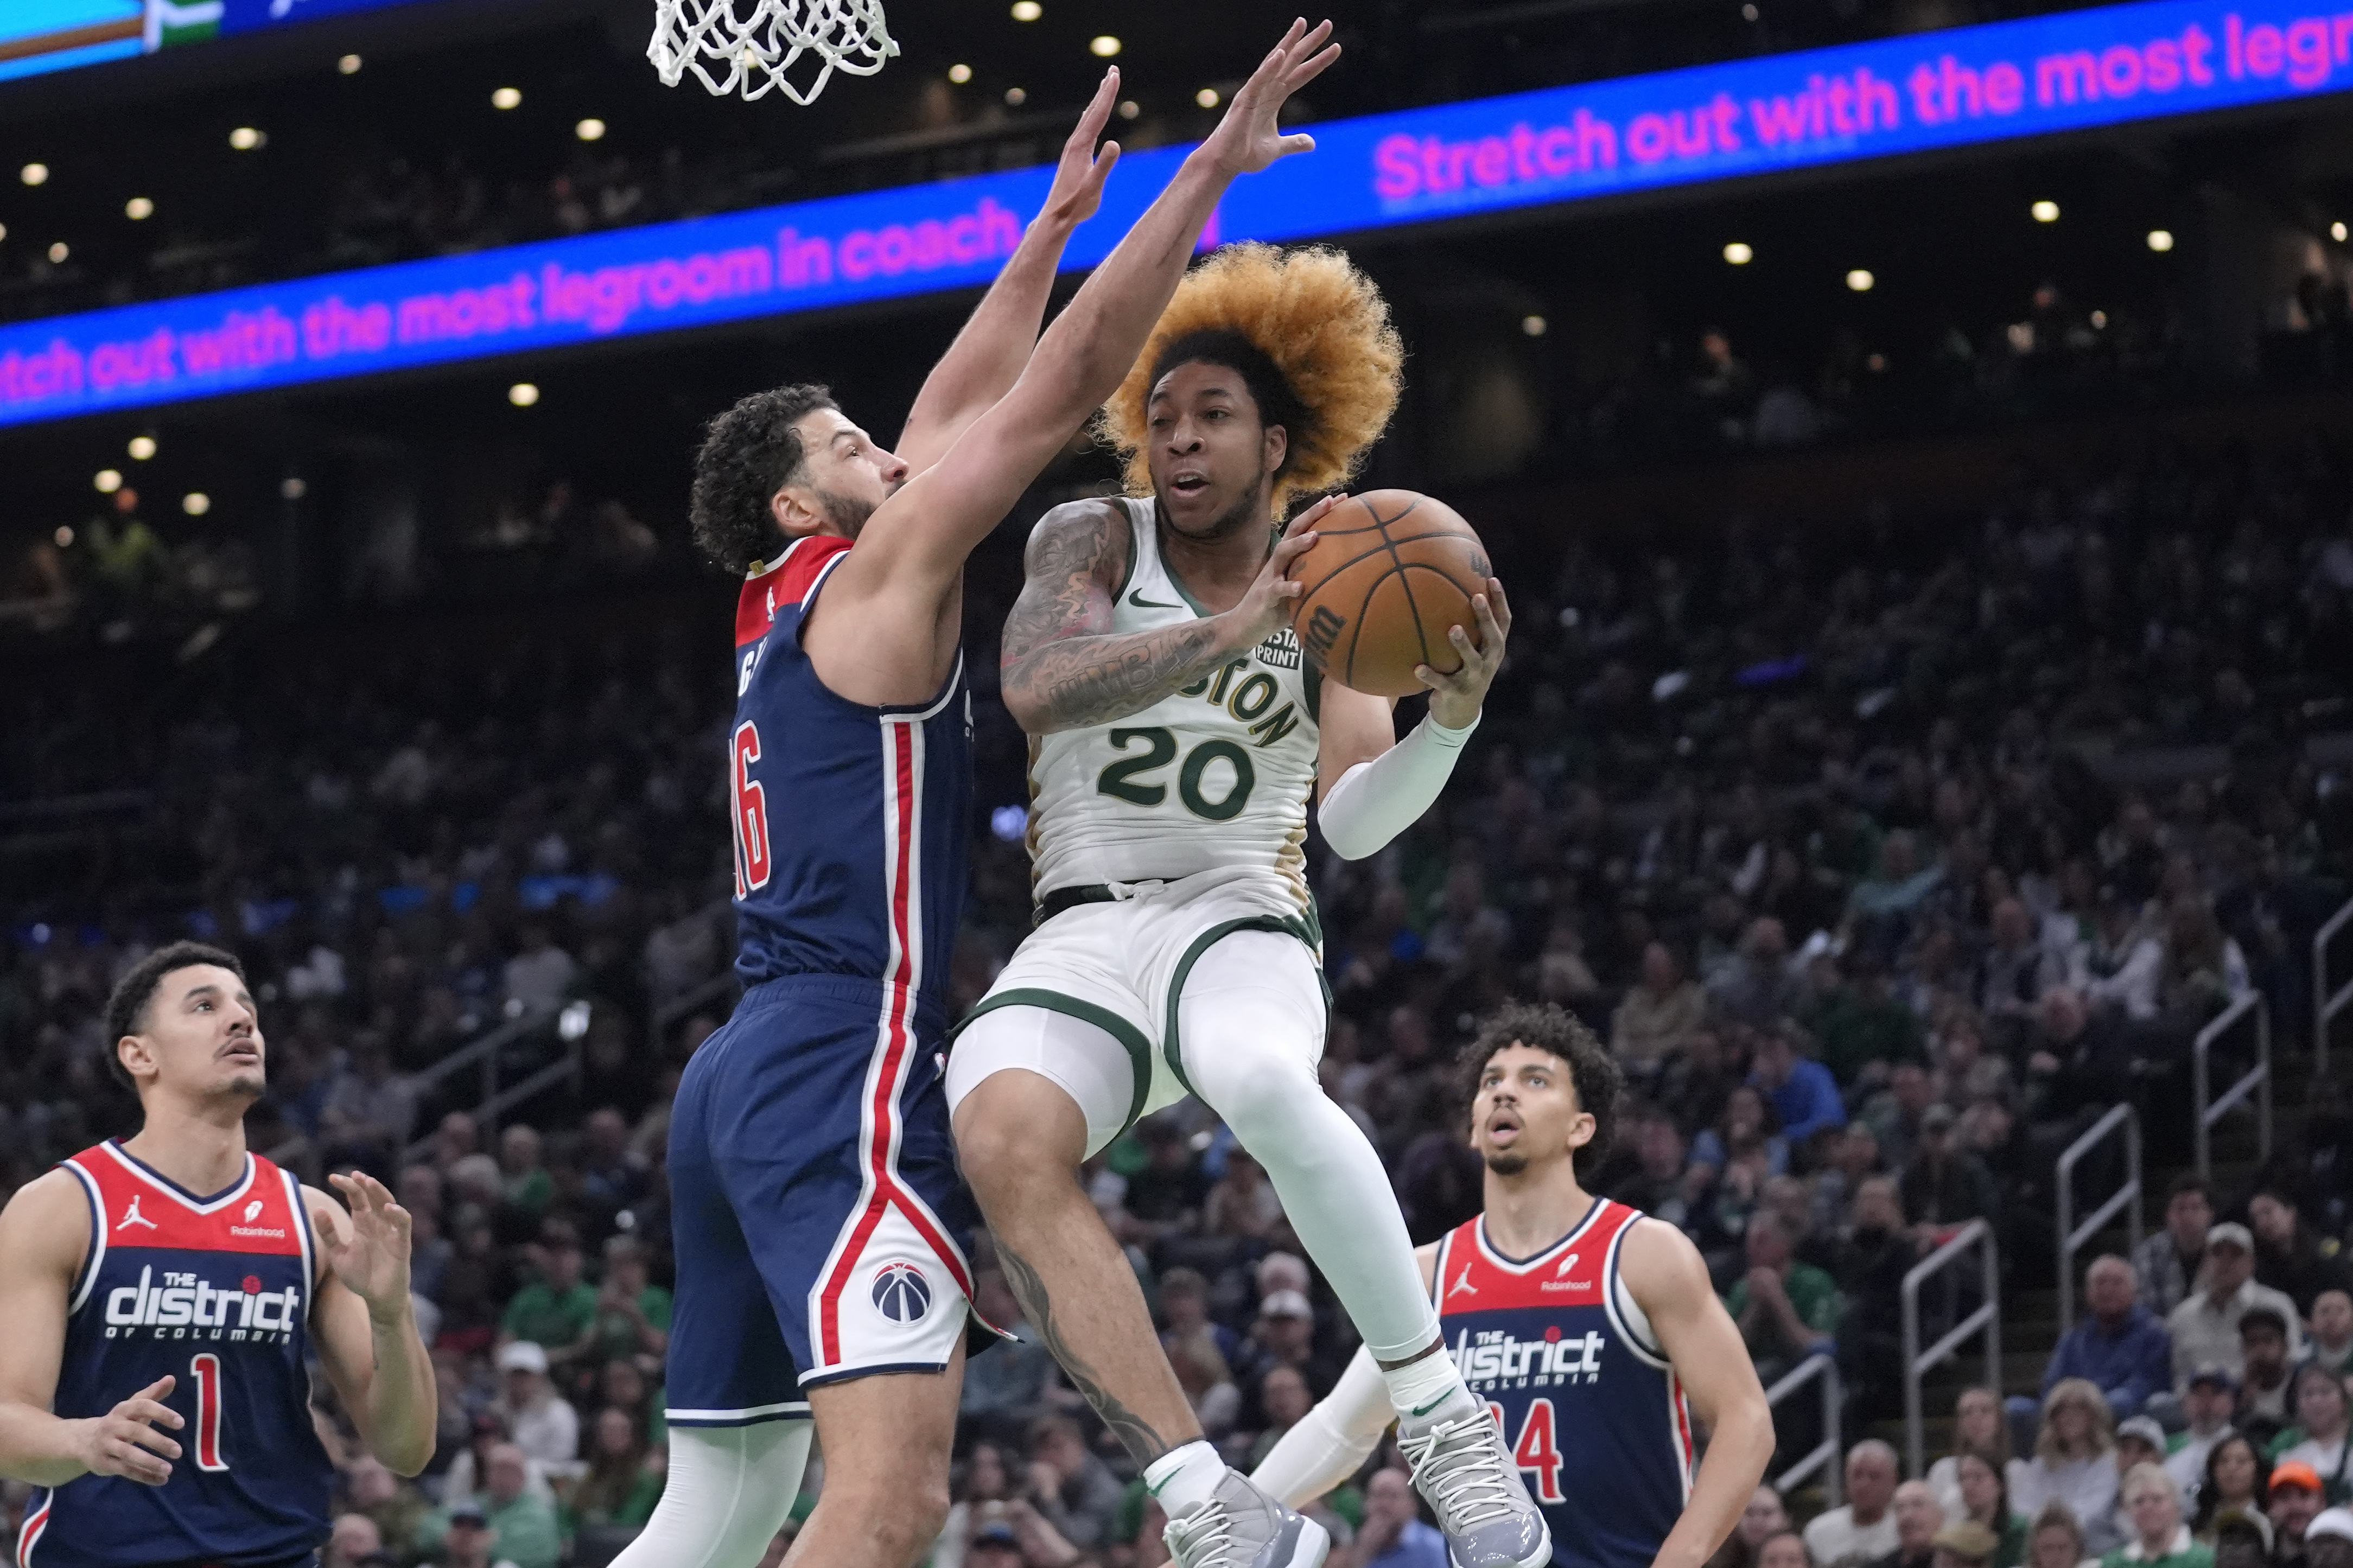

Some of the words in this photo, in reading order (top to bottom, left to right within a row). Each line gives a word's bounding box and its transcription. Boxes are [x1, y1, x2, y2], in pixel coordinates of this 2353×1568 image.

[1375, 109, 1618, 201] Stretch
[1627, 94, 1741, 165] out
[1750, 68, 1899, 145] with
[1908, 55, 2024, 124] the
[2036, 26, 2212, 105] most
[89, 329, 175, 390] out
[182, 308, 297, 374] with
[302, 298, 391, 357] the
[397, 273, 536, 342] most
[542, 246, 773, 331] legroom
[778, 228, 832, 286] in
[837, 199, 1023, 279] coach
[1256, 644, 1299, 667] PRINT
[1097, 726, 1256, 821] 20
[230, 1225, 286, 1239] Robinhood
[163, 1272, 197, 1287] THE
[1540, 1279, 1592, 1292] Robinhood
[105, 1263, 300, 1333] district
[105, 1326, 135, 1338] OF
[154, 1327, 291, 1346] COLUMBIA
[1476, 1330, 1505, 1345] THE
[1469, 1373, 1599, 1392] COLUMBIA
[190, 1353, 230, 1472] 1
